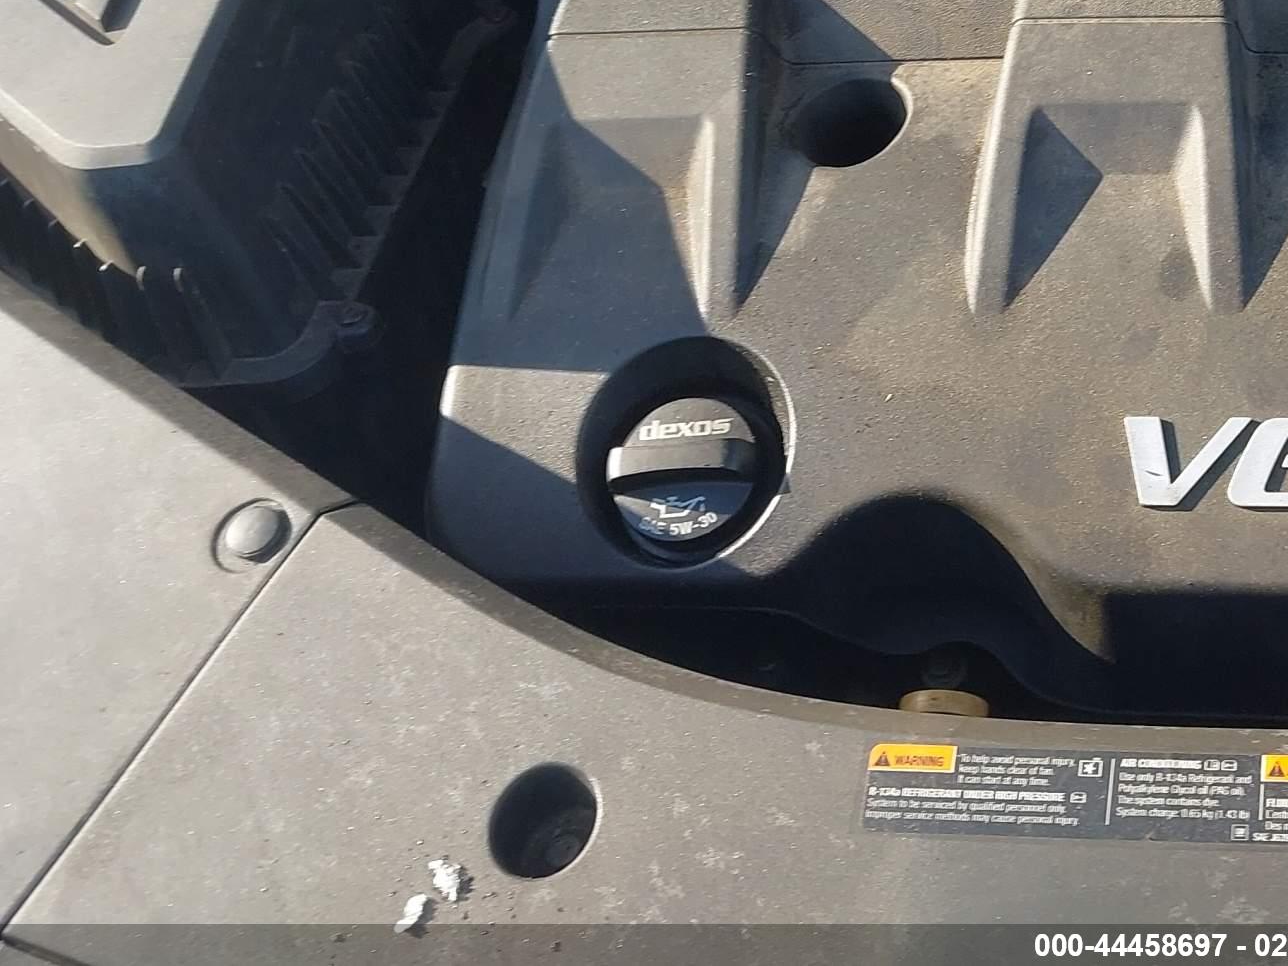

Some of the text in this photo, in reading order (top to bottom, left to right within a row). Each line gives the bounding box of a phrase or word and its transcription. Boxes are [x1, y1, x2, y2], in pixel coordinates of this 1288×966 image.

[638, 418, 735, 441] dexos
[638, 511, 719, 535] SAE 5W-30
[894, 755, 944, 767] WARNING
